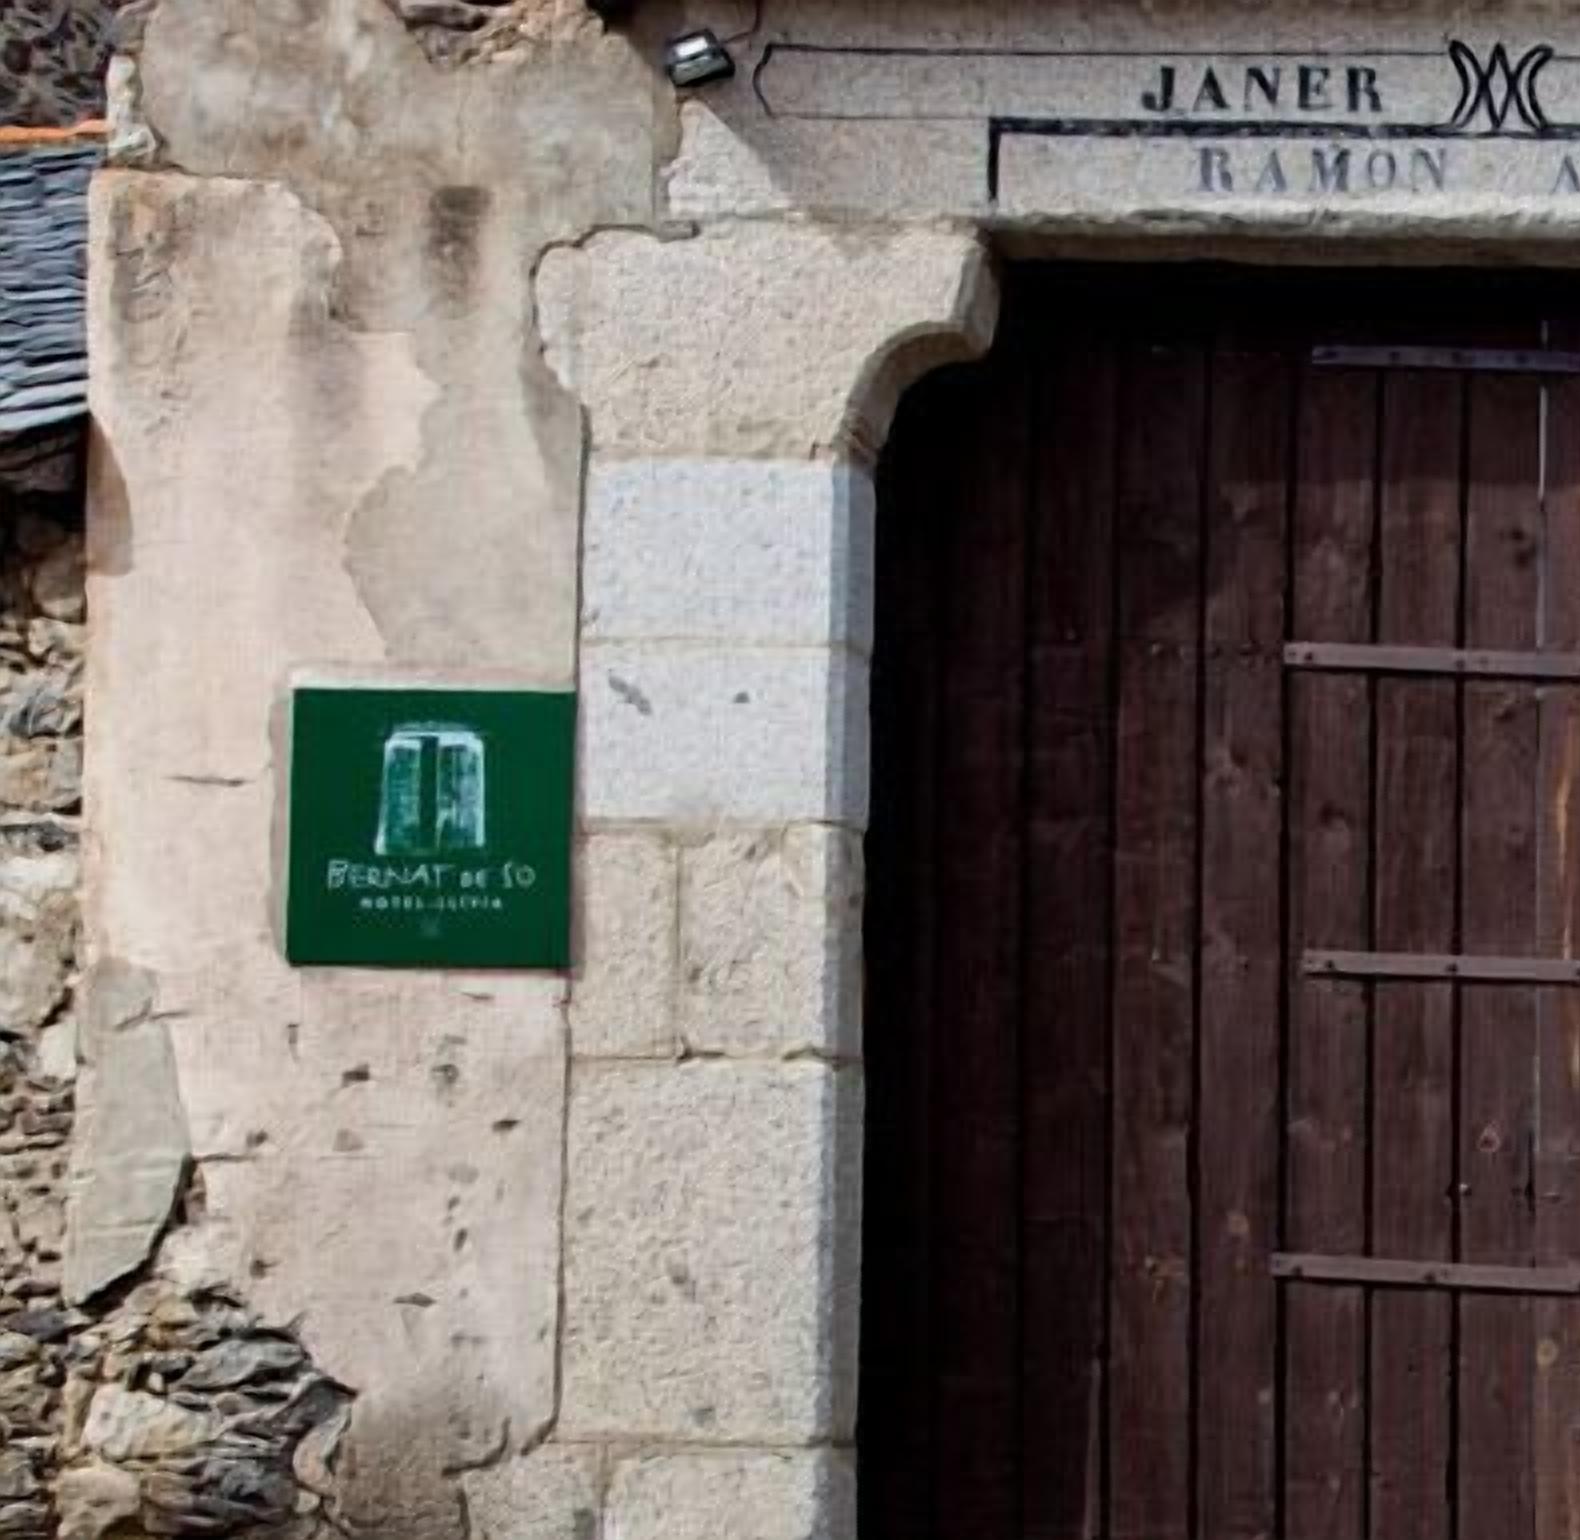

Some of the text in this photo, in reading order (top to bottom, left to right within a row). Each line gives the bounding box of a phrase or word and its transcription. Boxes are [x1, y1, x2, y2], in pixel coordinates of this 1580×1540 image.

[1141, 64, 1384, 114] JANER
[1200, 146, 1449, 194] RAMON
[327, 859, 454, 889] BERNAT
